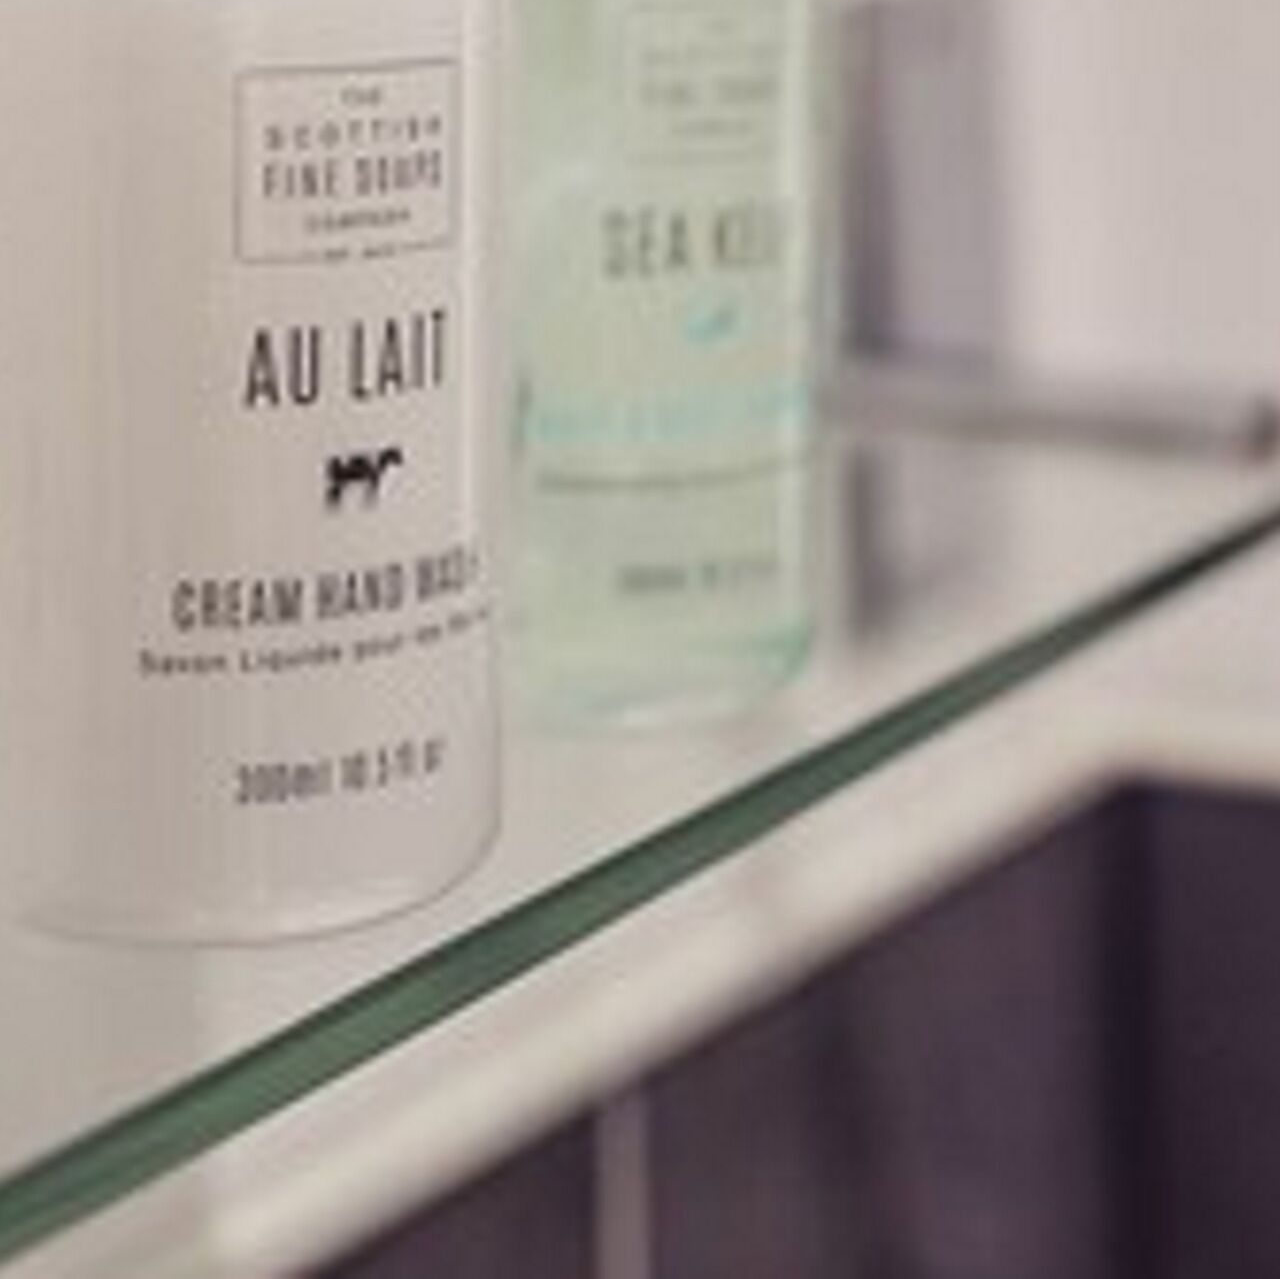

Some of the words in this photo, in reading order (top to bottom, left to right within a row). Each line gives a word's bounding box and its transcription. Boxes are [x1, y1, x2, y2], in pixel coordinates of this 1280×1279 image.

[262, 159, 338, 199] FINE
[243, 326, 322, 409] AU
[349, 306, 445, 401] LAIT
[170, 579, 303, 631] CREAM
[317, 562, 404, 619] HAND
